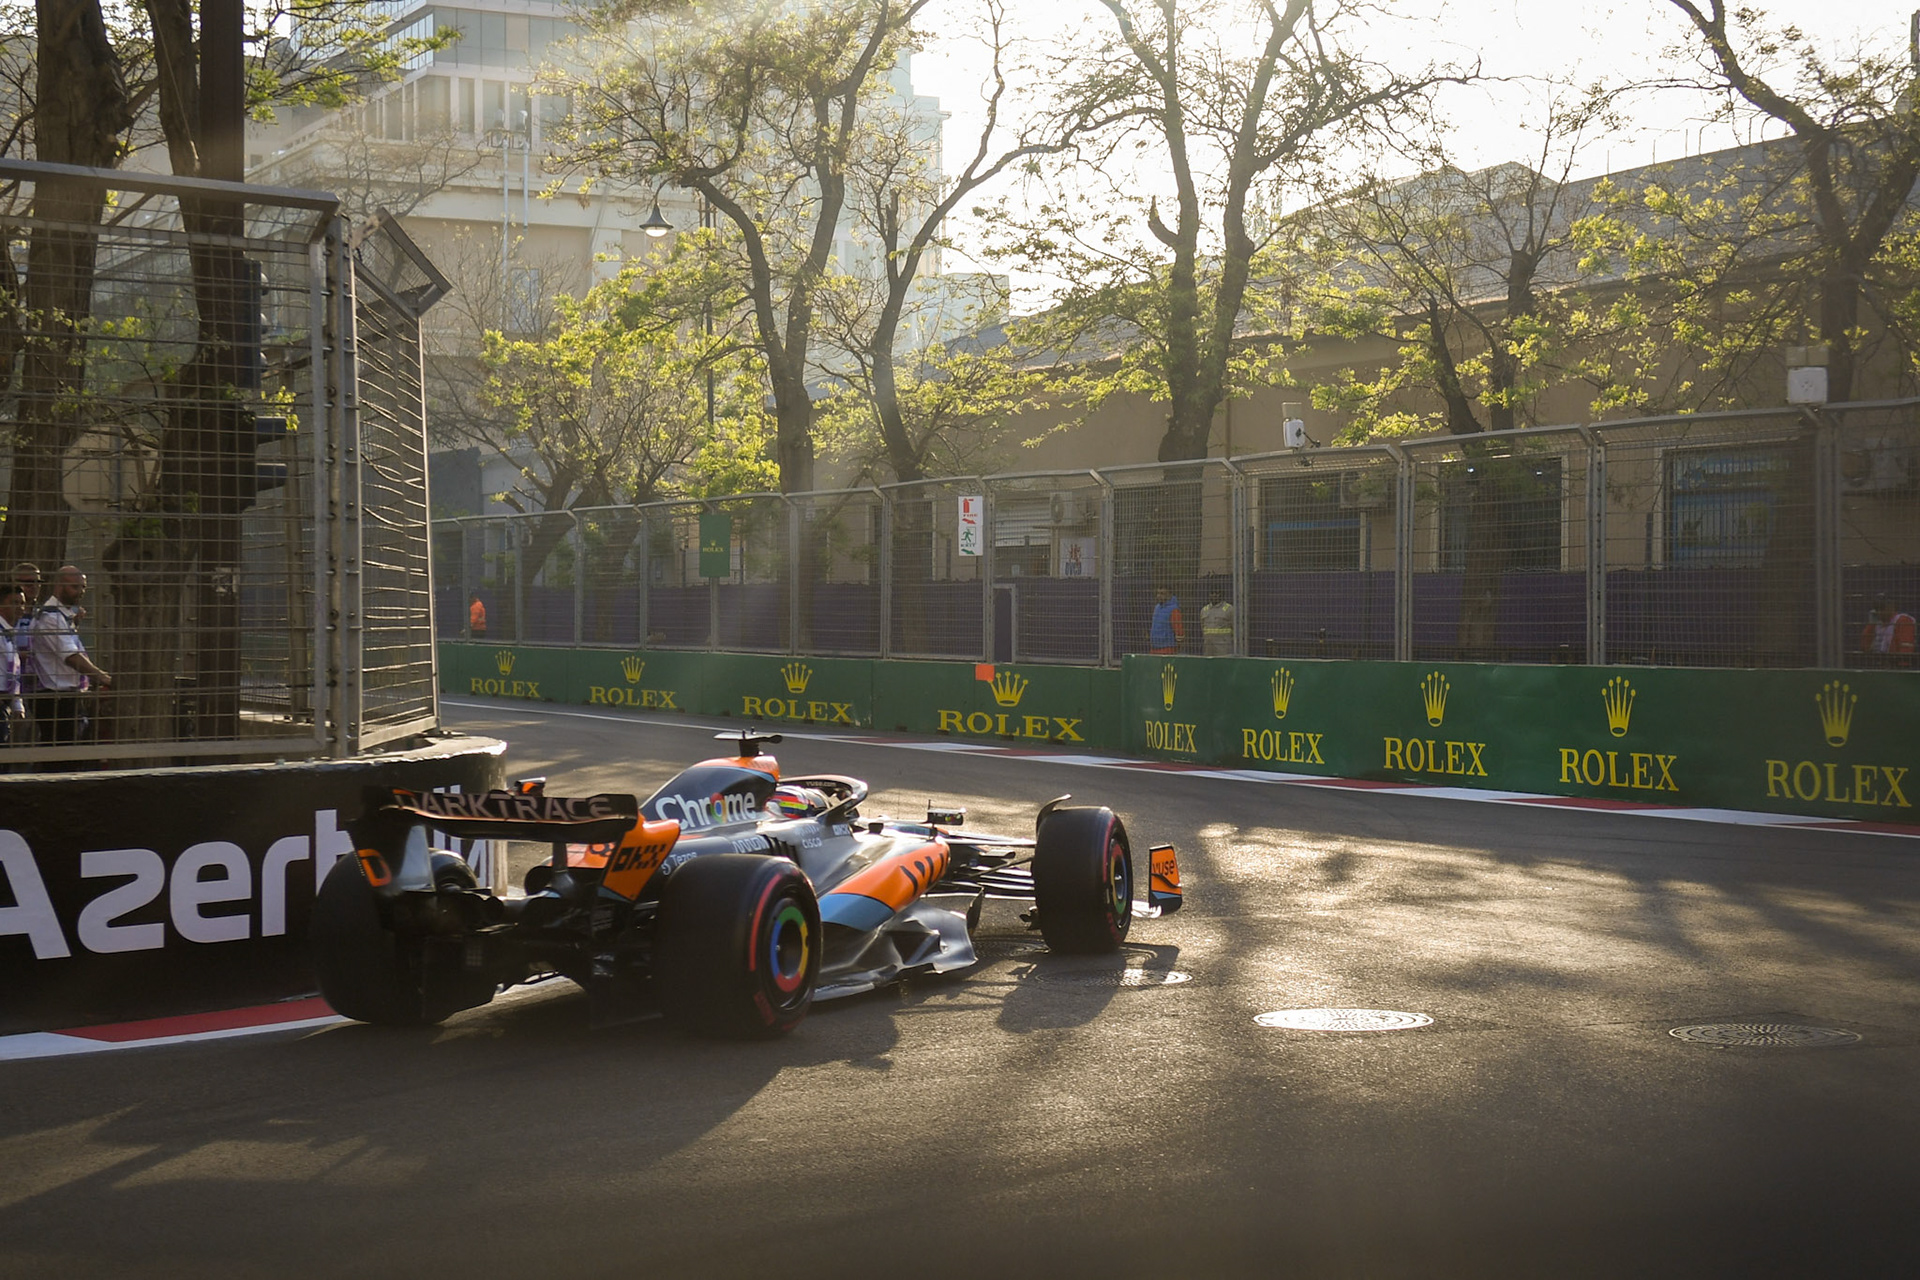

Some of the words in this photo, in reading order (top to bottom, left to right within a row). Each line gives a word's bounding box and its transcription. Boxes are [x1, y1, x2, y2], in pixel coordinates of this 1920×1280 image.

[470, 677, 540, 698] ROLEX
[590, 686, 678, 709] ROLEX
[742, 693, 853, 723] ROLEX
[937, 705, 1086, 742] ROLEX
[1145, 719, 1197, 753] ROLEX
[1242, 728, 1325, 764] ROLEX
[1383, 737, 1489, 777] ROLEX
[1559, 748, 1680, 792] ROLEX
[1766, 760, 1912, 807] ROLEX
[393, 789, 613, 823] DARKTRACE
[655, 792, 756, 830] Chrome
